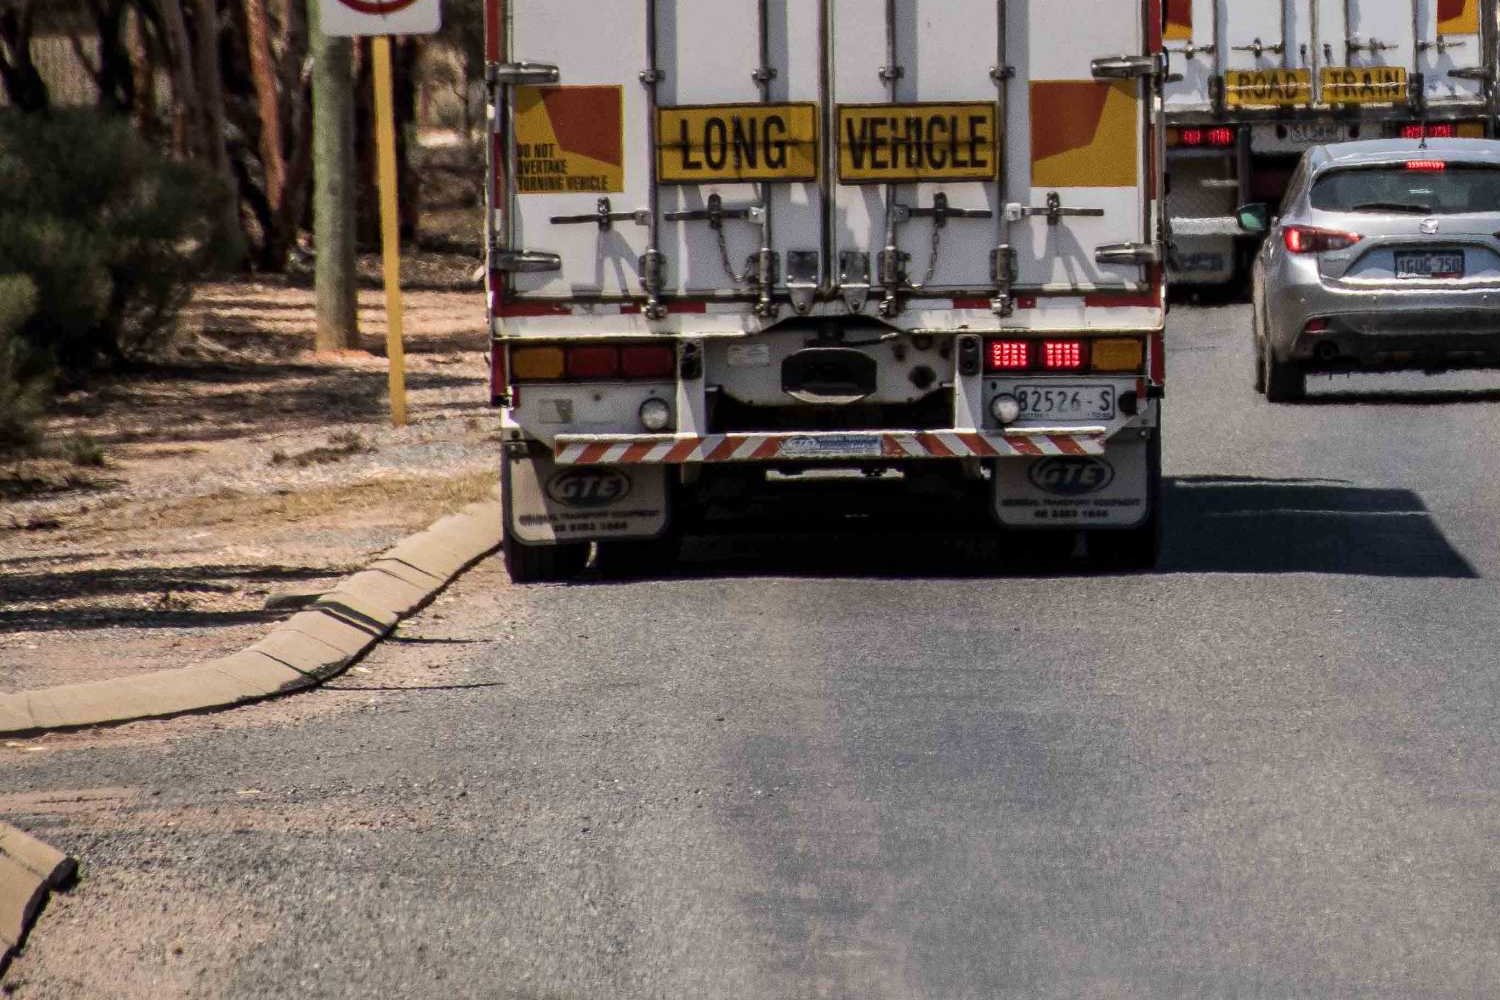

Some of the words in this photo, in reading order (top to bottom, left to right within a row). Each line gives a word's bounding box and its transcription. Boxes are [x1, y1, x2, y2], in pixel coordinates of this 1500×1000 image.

[1236, 73, 1299, 100] ROAD
[1329, 69, 1400, 97] TRAIN
[534, 143, 555, 158] NOT
[679, 115, 788, 171] LONG
[845, 115, 988, 170] VEHICLE
[516, 159, 569, 175] OVERTAKE
[556, 473, 627, 499] GTE
[1039, 462, 1107, 486] GTE
